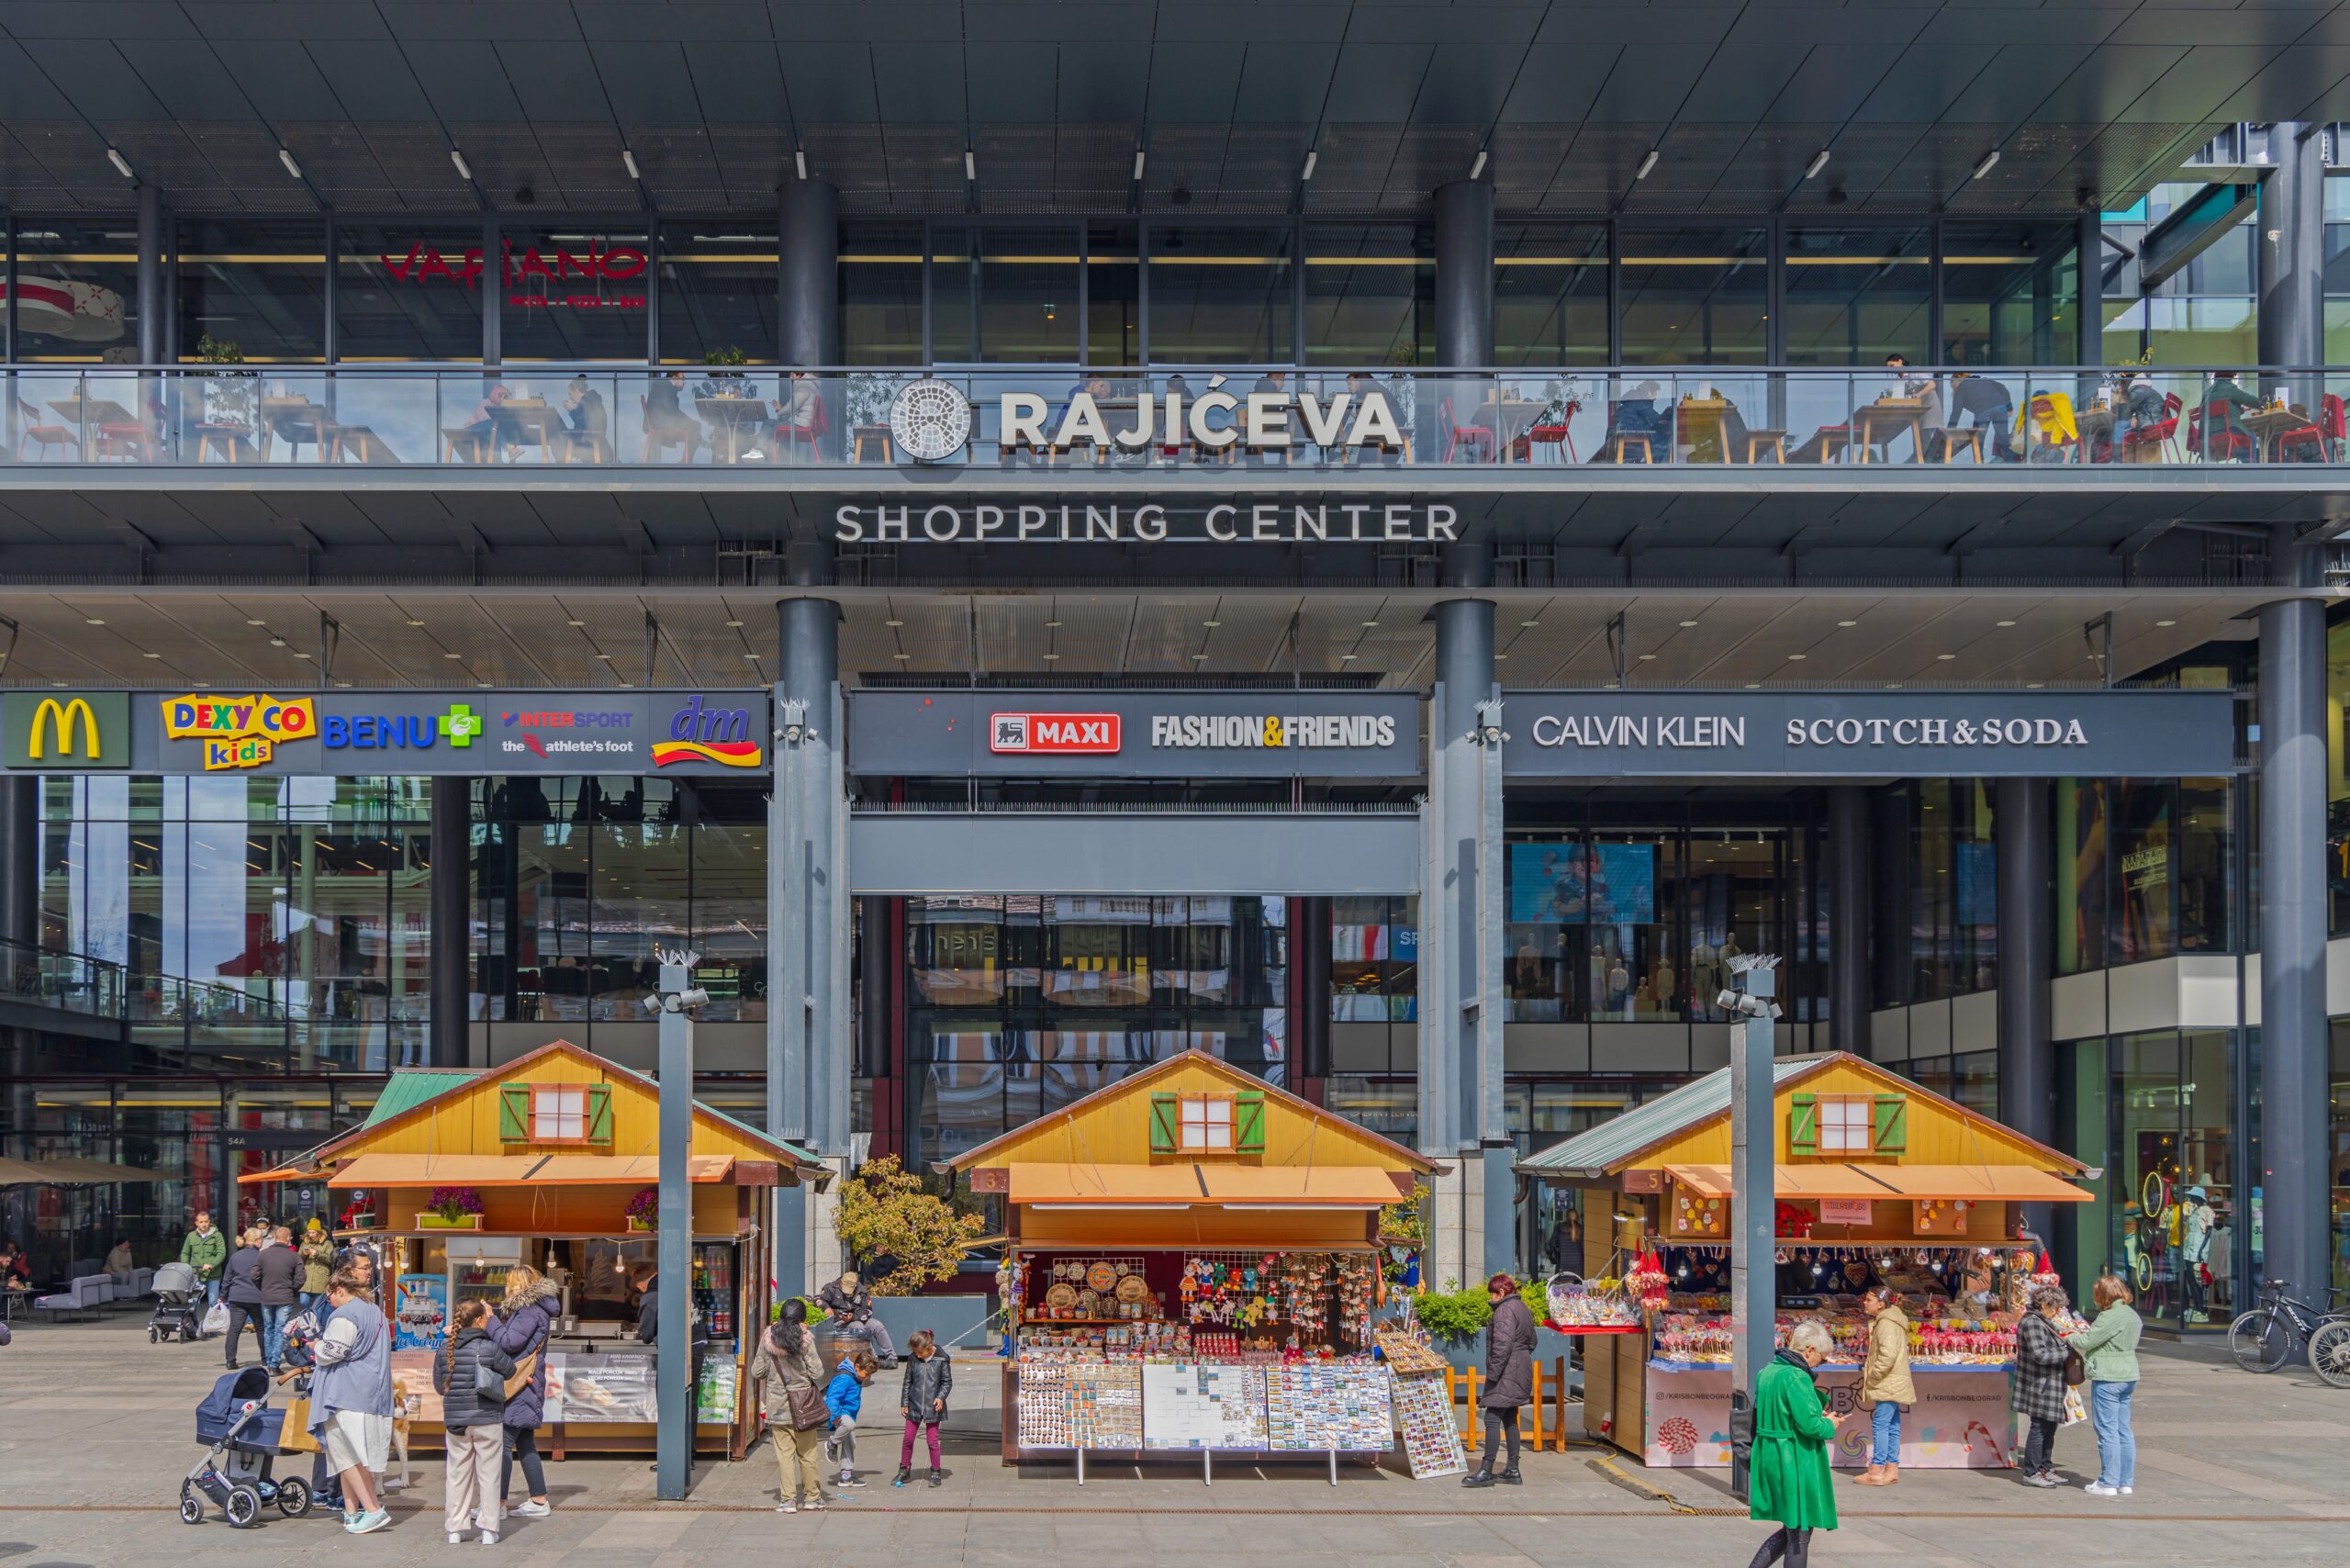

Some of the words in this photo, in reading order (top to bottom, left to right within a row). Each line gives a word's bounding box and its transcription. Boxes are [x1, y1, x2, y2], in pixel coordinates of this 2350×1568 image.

[380, 237, 647, 290] VAPIANO
[509, 295, 549, 308] PASTA
[566, 295, 602, 308] PIZZA
[620, 295, 646, 308] BAR
[1001, 373, 1404, 448] RAJIĆEVA
[834, 504, 1168, 543] SHOPPING
[1204, 504, 1458, 543] CENTER
[174, 703, 253, 731] DEXY
[263, 705, 307, 733] CO
[520, 711, 633, 728] INTERSPORT
[669, 694, 750, 742] dm
[1151, 715, 1396, 748] FASHION&FRIENDS
[1531, 715, 1649, 747] CALVIN
[1656, 715, 1745, 747] KLEIN
[323, 715, 437, 749] BENU
[1036, 722, 1111, 745] MAXI
[1785, 718, 2089, 746] SCOTCH&SODA
[210, 742, 268, 766] kids
[501, 740, 525, 753] the
[604, 740, 633, 753] foot
[228, 1137, 245, 1146] 54A
[1649, 1173, 1658, 1189] 5
[2285, 1305, 2308, 1332] SCOTT
[396, 1336, 410, 1348] Ice
[412, 1336, 442, 1348] Cream
